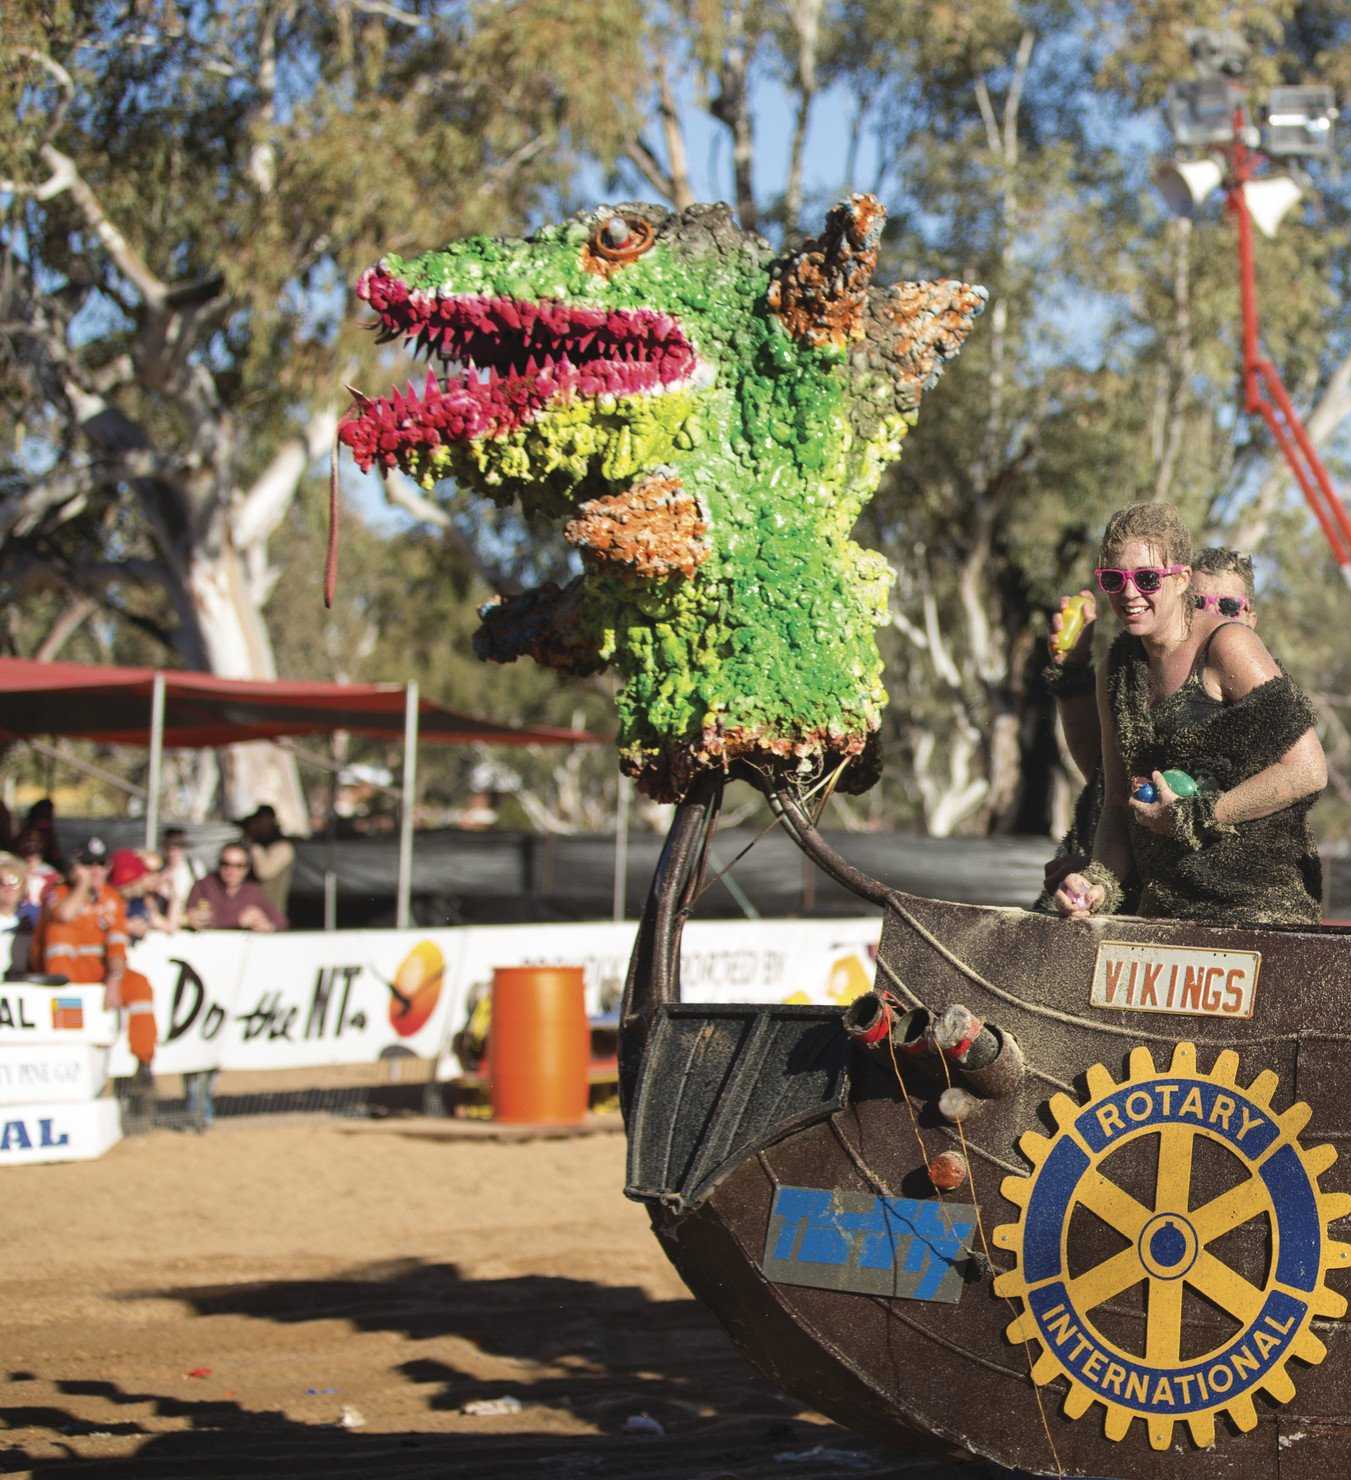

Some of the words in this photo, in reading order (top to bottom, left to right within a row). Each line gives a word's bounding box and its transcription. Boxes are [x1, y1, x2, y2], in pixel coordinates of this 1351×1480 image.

[163, 957, 226, 1043] Do
[236, 991, 299, 1042] the
[1104, 959, 1247, 1014] VIKINGS
[1094, 1084, 1266, 1142] ROTARY
[1041, 1302, 1297, 1407] INTERNATIONAL
